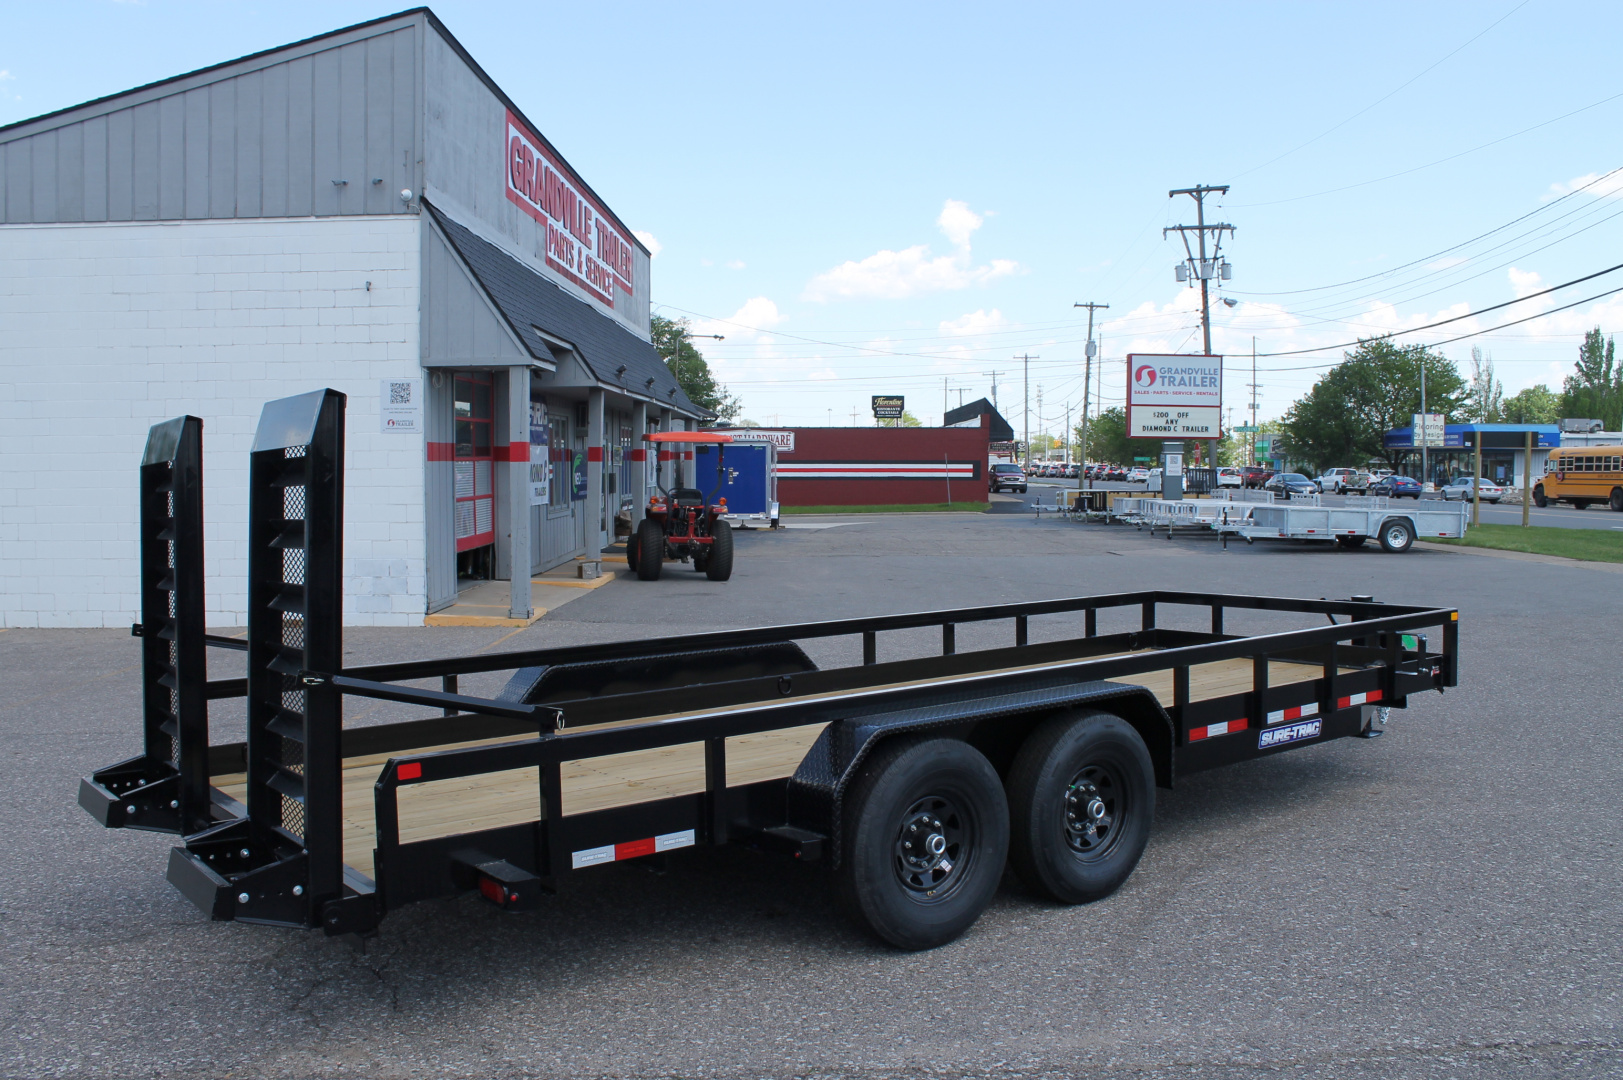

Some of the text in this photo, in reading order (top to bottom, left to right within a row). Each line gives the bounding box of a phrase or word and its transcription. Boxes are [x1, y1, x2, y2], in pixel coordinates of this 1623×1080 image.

[510, 135, 632, 284] GRANDVILLE TRAILER
[549, 223, 613, 298] PARTS & SERVICE
[1159, 367, 1219, 376] GRANDVILLE
[1159, 375, 1218, 388] TRAILER
[1261, 721, 1320, 746] SURE-TRAC
